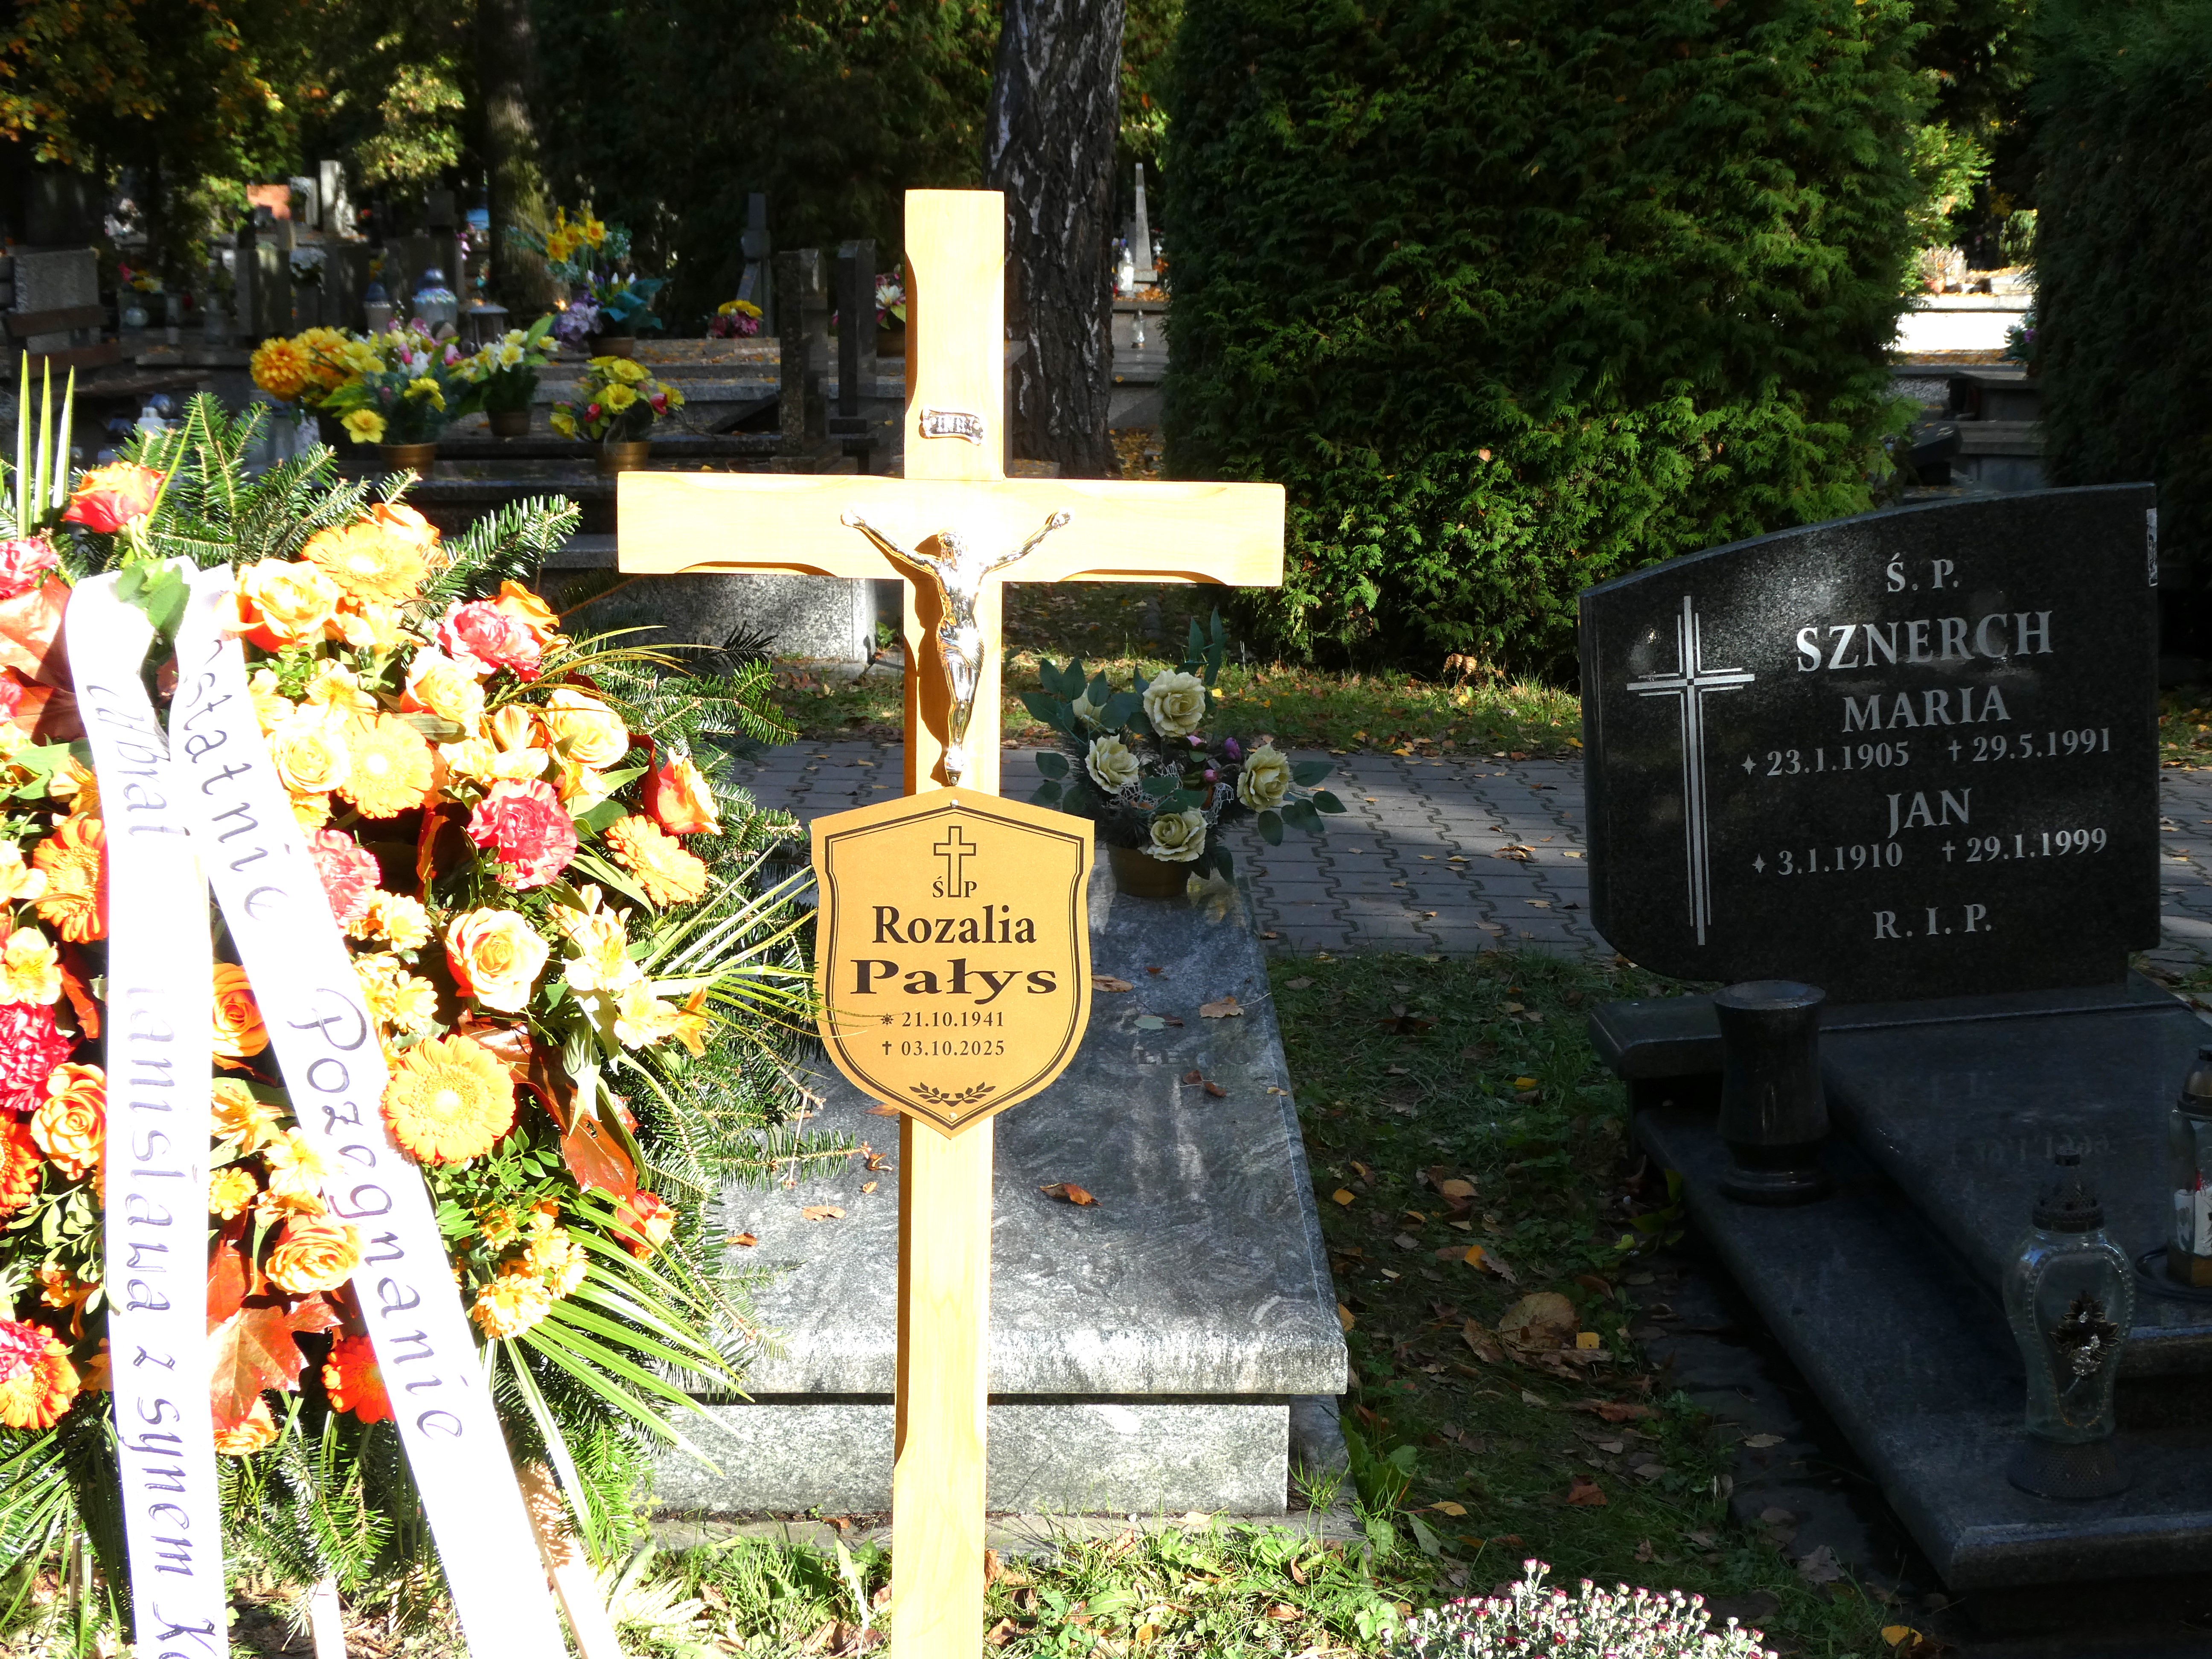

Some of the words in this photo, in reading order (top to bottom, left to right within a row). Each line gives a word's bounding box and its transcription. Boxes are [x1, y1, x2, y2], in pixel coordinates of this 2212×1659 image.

[1886, 552, 1918, 592] Ś.
[1932, 559, 1959, 588] P.
[1796, 610, 2054, 672] SZNERCH
[1842, 686, 2011, 732] MARIA
[1767, 742, 1909, 776] 23.1.1905
[1973, 728, 2110, 761] 29.5.1991
[1887, 789, 1970, 838] JAN
[1778, 842, 1902, 875] 3.1.1910
[1967, 828, 2107, 862] 29.1.1999
[964, 881, 977, 898] P
[872, 905, 1036, 943] Rozalia
[1875, 911, 1912, 938] R.
[1965, 904, 1991, 932] P.
[850, 958, 1057, 1005] Pałys
[902, 1011, 1004, 1027] 21.10.1941
[901, 1040, 1004, 1056] 03.10.2025
[133, 1346, 175, 1371] z
[117, 1397, 194, 1576] synem
